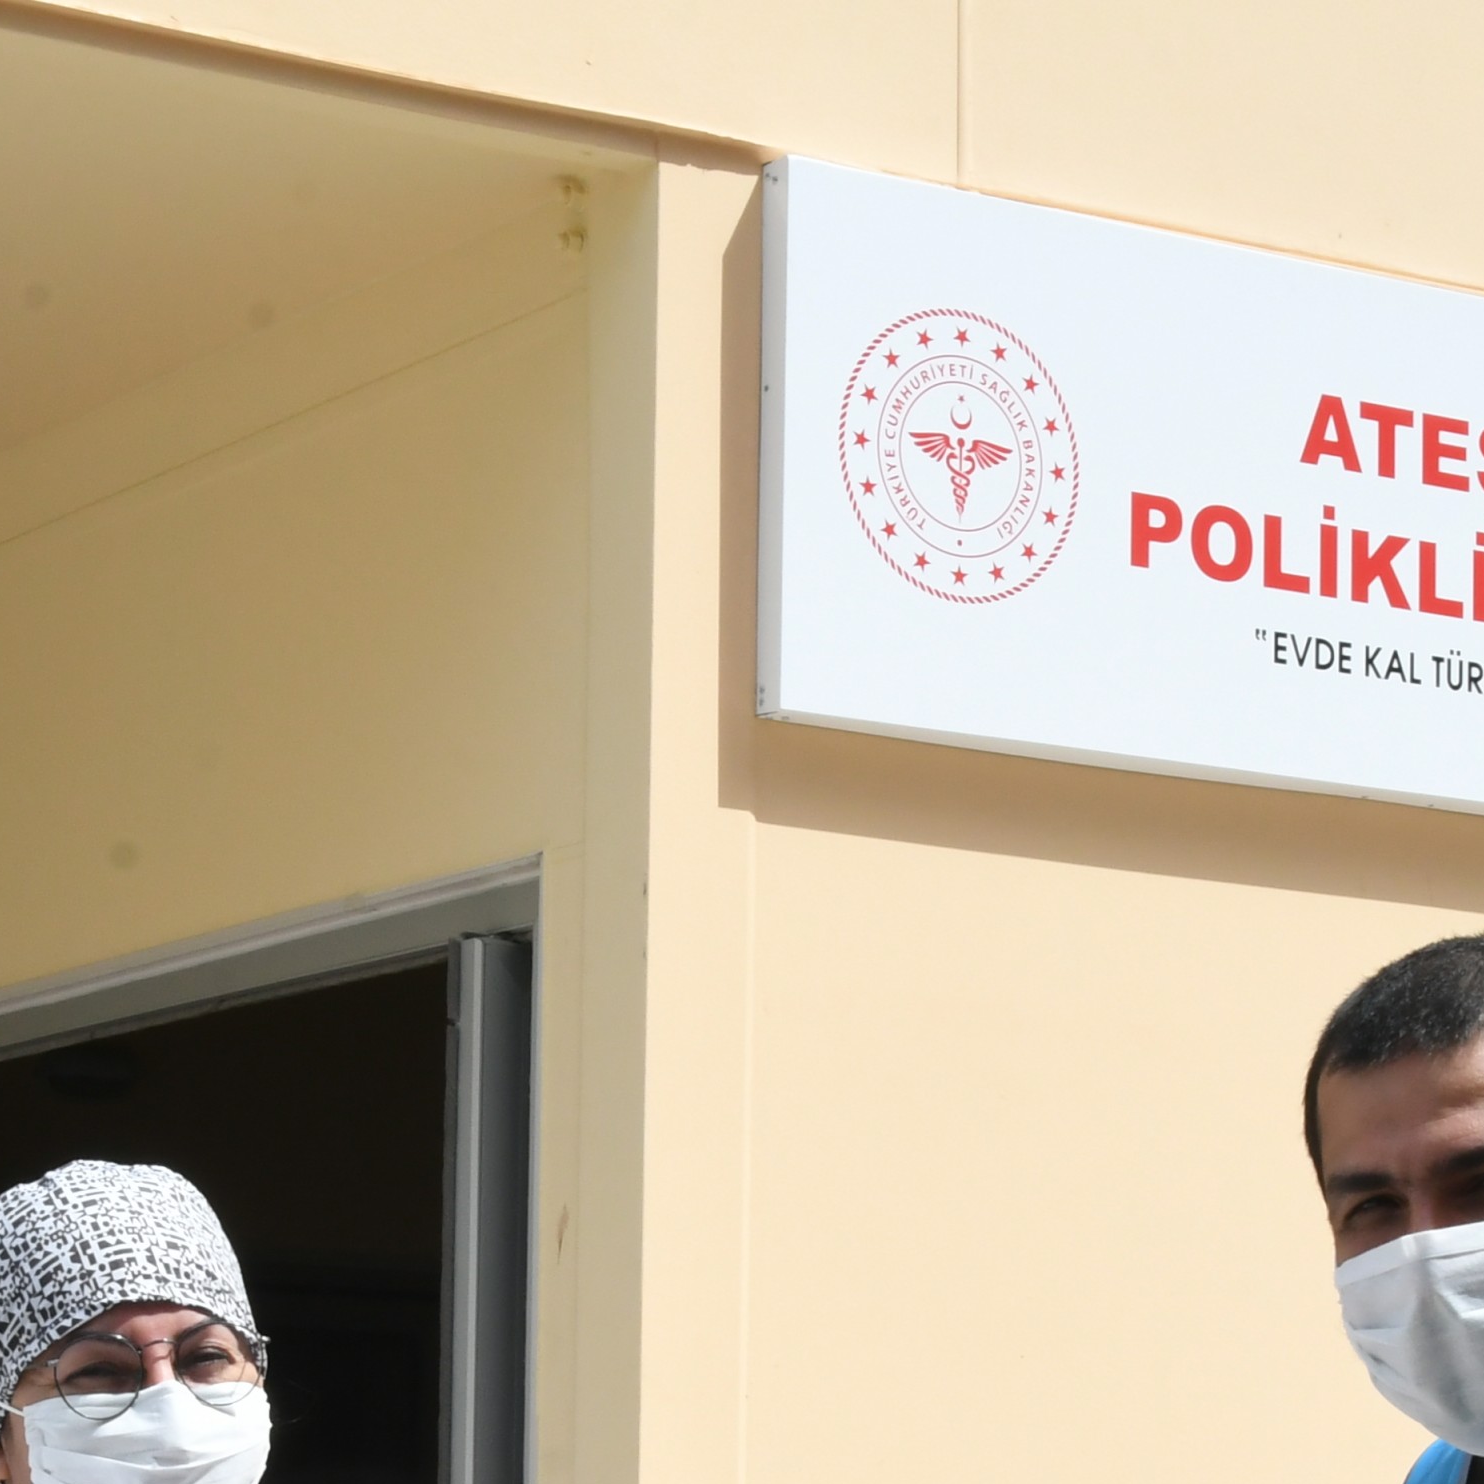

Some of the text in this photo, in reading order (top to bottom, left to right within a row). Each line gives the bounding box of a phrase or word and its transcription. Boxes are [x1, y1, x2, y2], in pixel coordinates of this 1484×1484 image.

[979, 372, 1029, 433] SAĞLIK
[997, 439, 1036, 540] BAKANLIĞI
[1364, 645, 1422, 685] KAL
